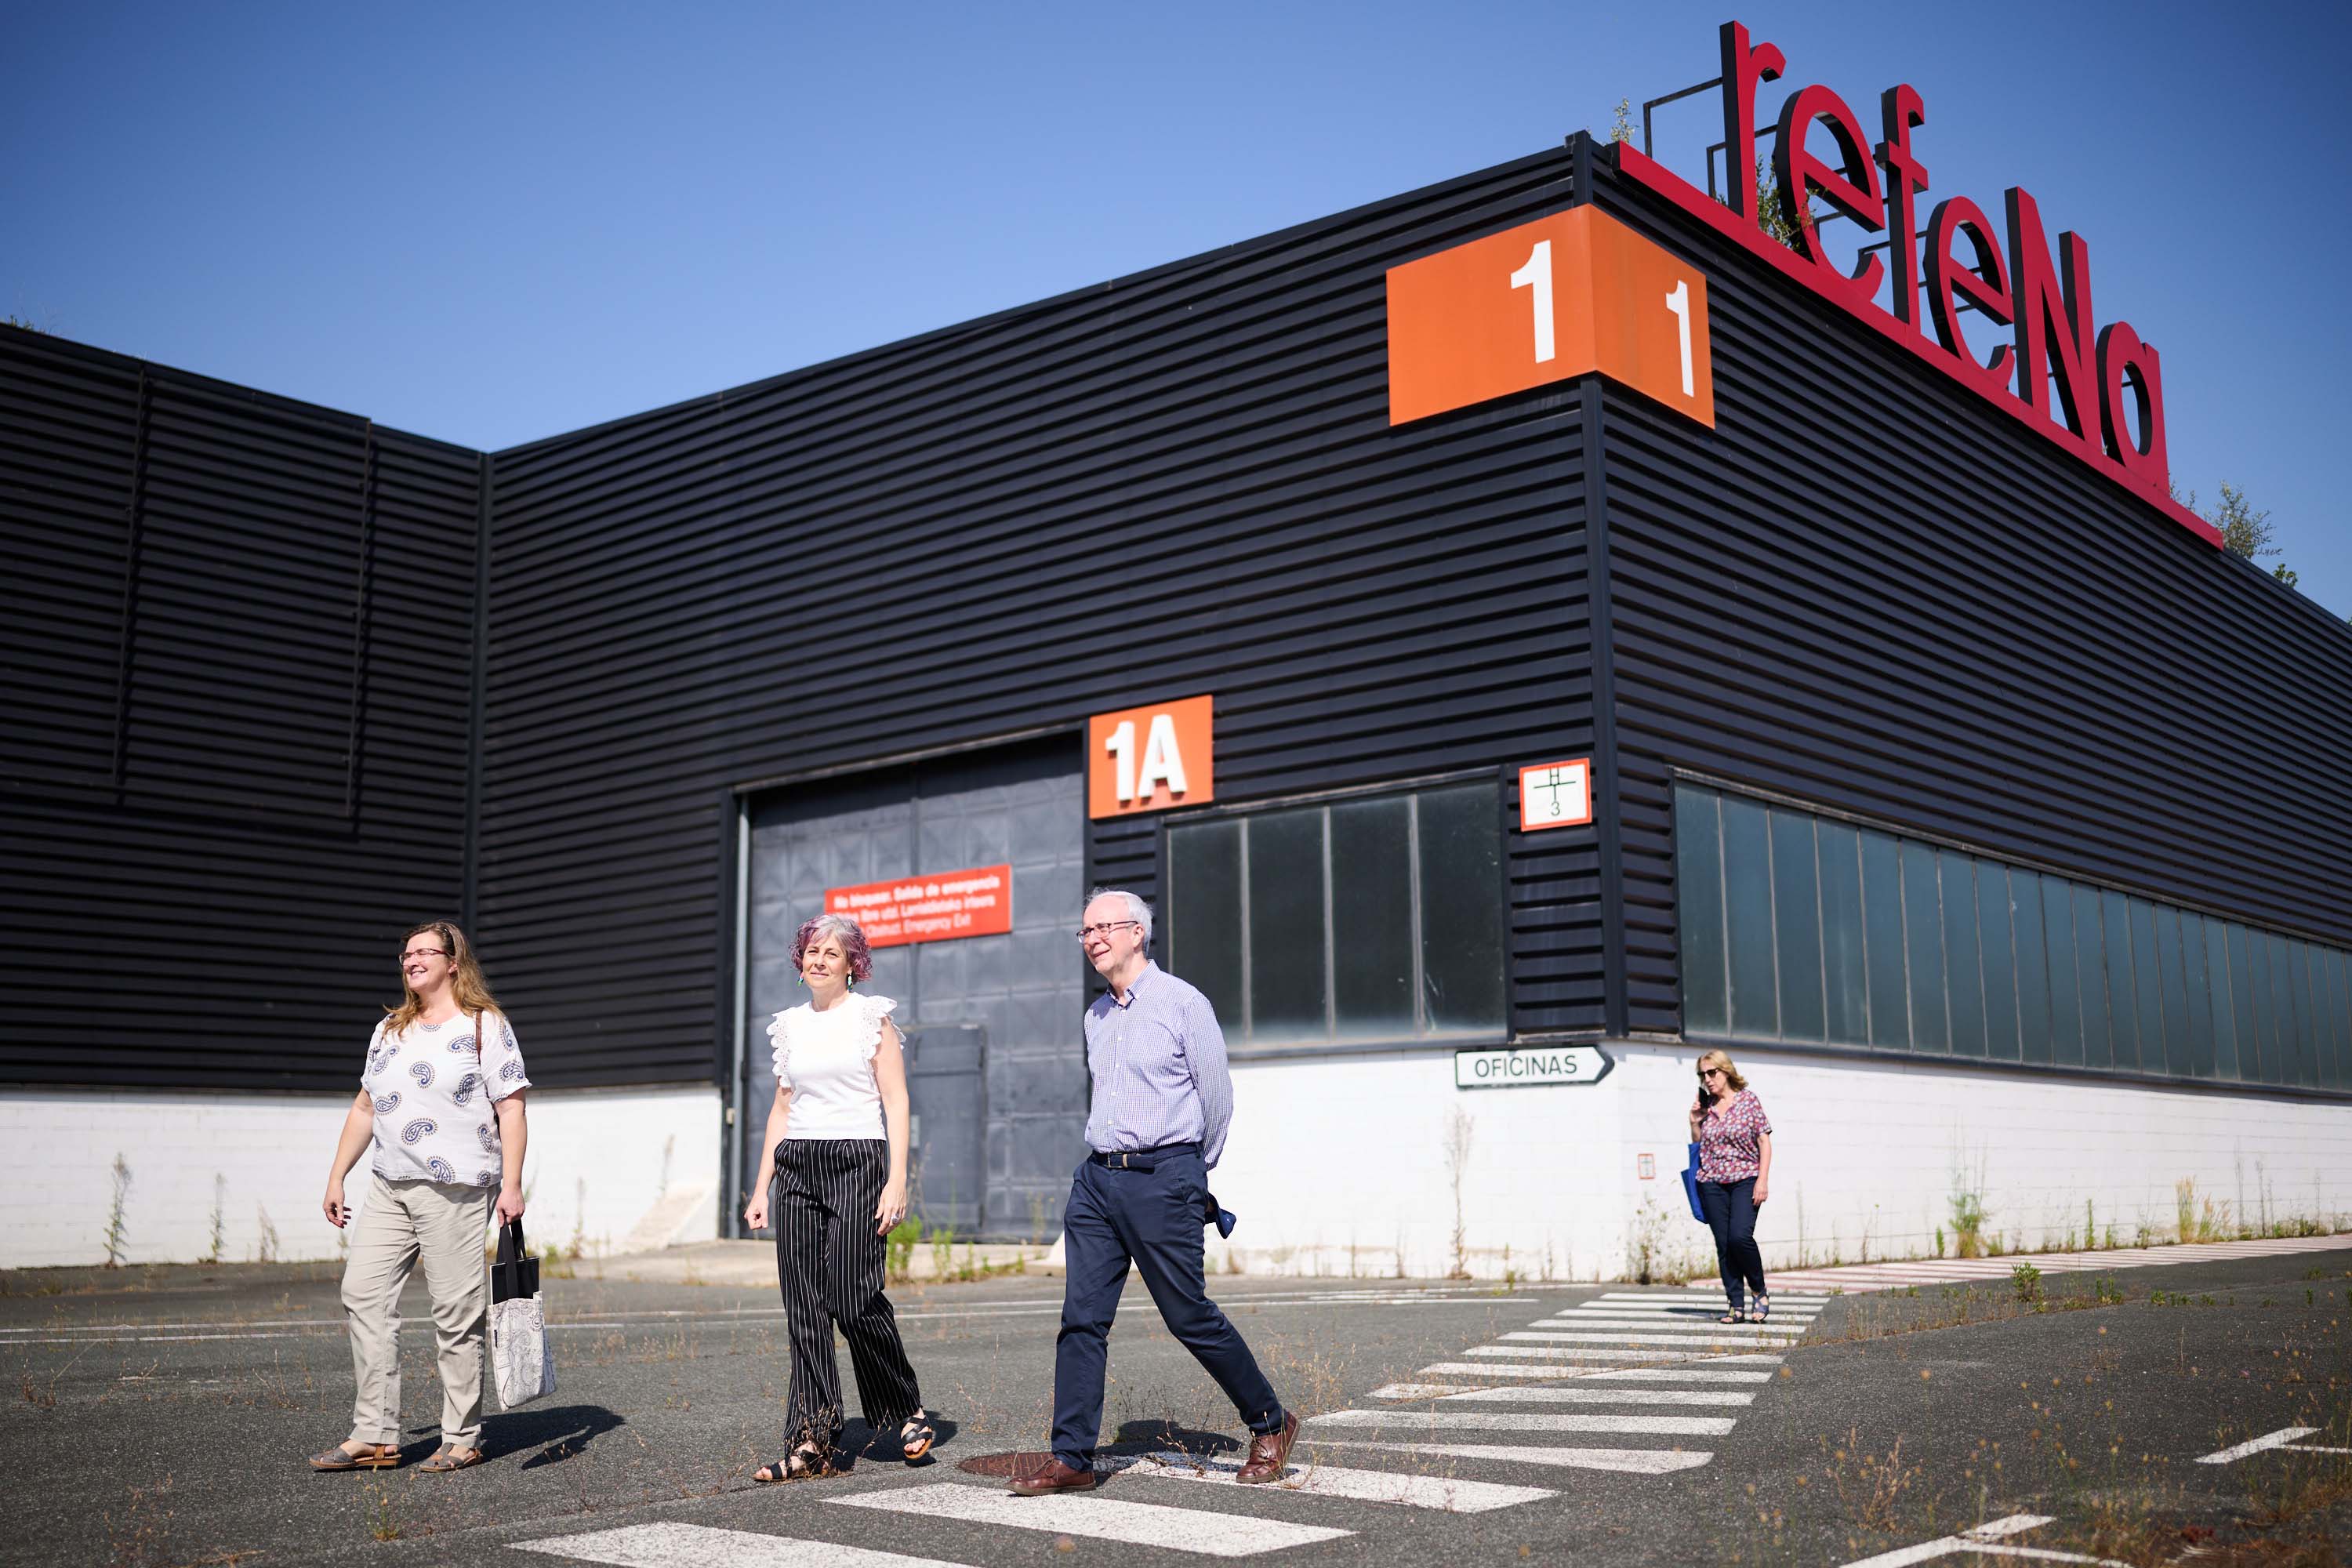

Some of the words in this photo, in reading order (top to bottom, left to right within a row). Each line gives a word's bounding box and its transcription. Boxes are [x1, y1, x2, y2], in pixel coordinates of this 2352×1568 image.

[1510, 239, 1555, 364] 1
[1665, 279, 1694, 398] 1
[1105, 713, 1189, 801] 1A
[1550, 801, 1561, 816] 3
[1474, 1054, 1577, 1079] OFICINAS
